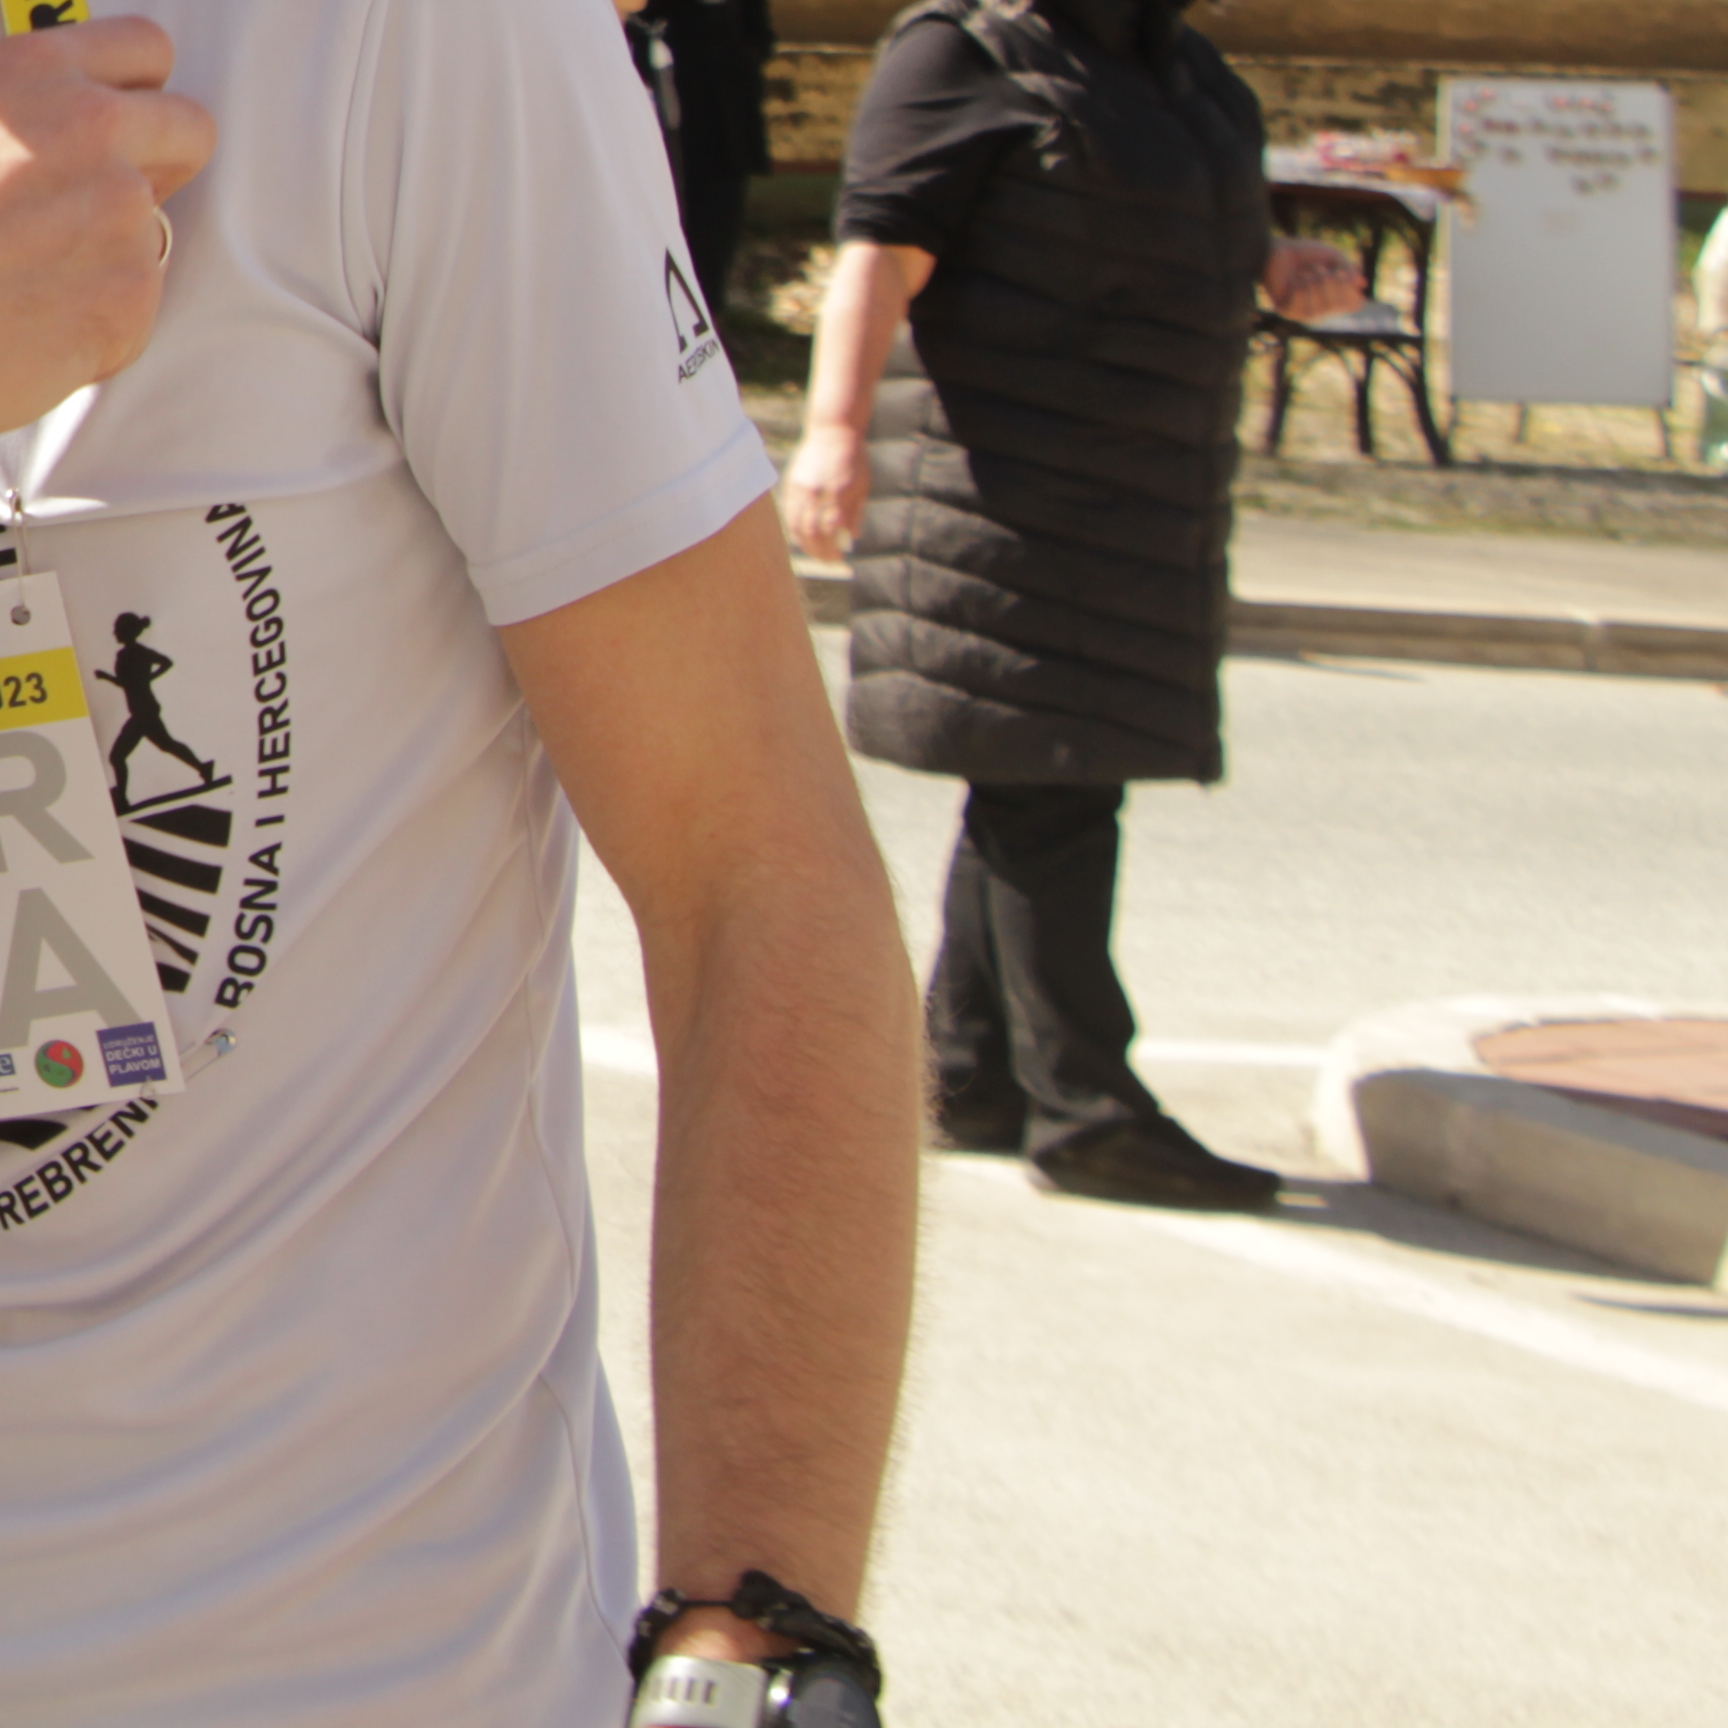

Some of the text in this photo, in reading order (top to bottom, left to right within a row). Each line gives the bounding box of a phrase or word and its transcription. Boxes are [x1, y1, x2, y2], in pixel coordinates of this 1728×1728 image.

[205, 502, 292, 1010] BOSNA I HERCEGOVINA
[146, 1044, 158, 1056] U
[109, 1057, 162, 1075] PLAVOM
